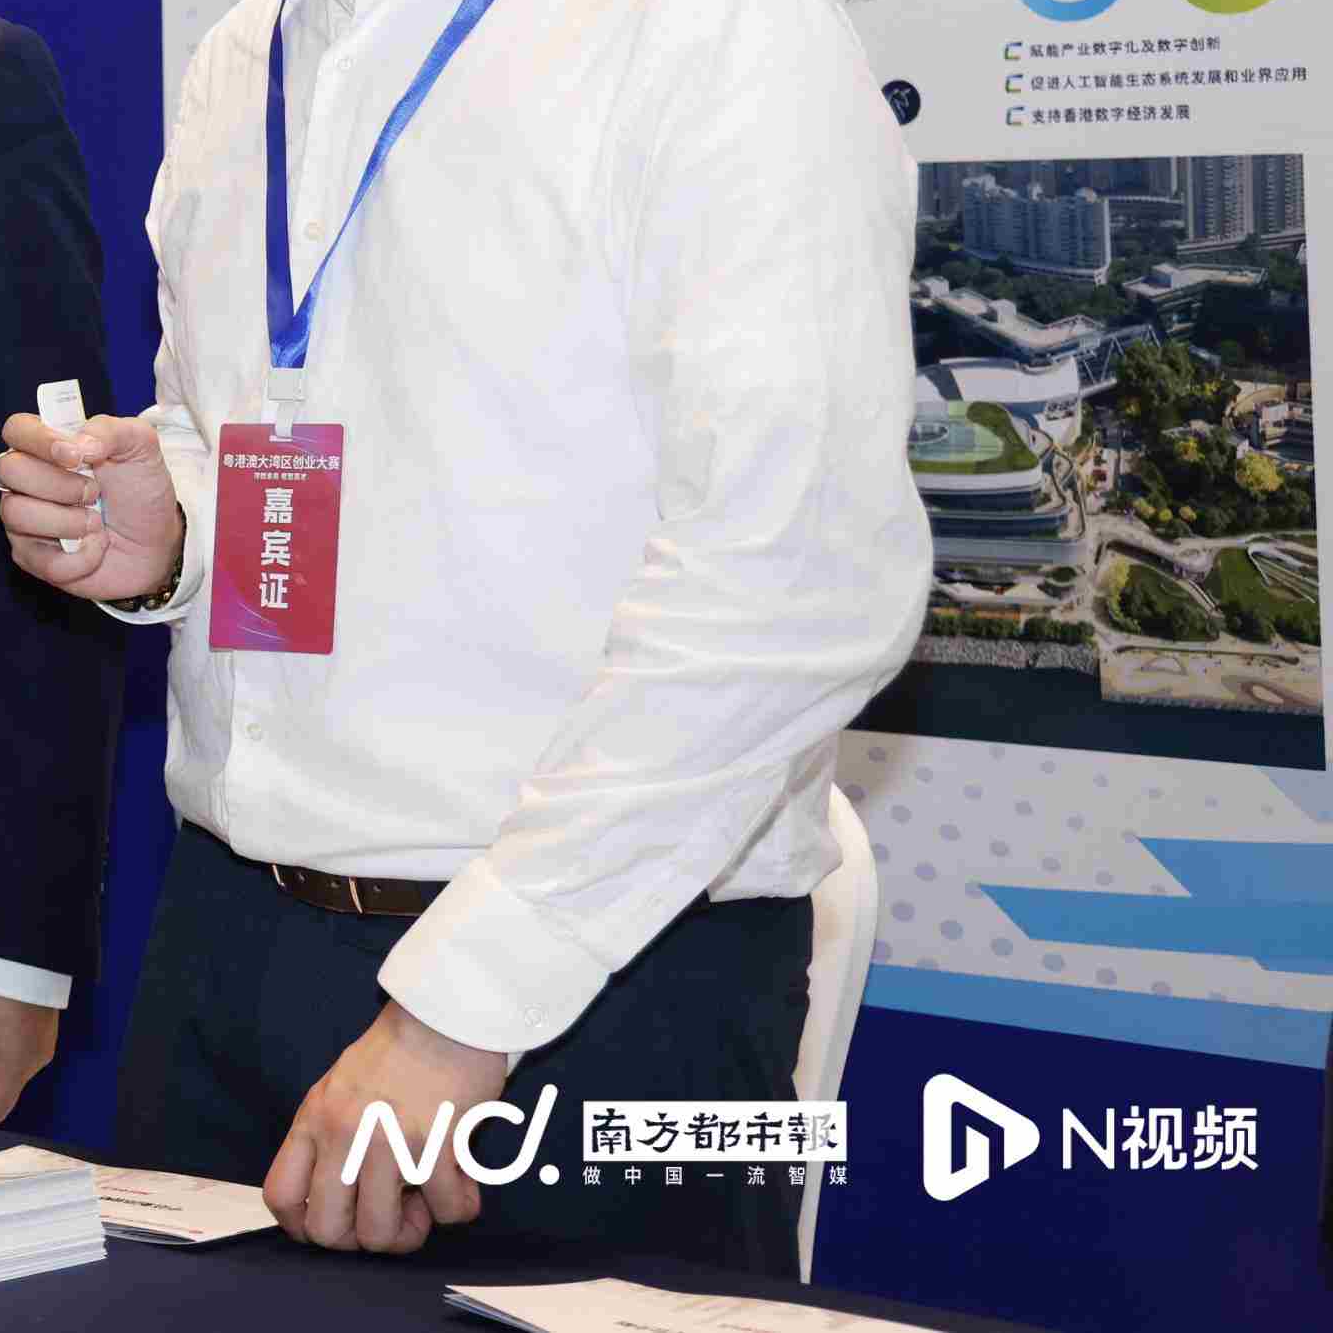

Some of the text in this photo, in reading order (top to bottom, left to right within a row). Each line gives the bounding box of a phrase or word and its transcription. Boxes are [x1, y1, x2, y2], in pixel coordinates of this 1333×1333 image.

[1032, 105, 1190, 125] 支持香港数字经济发展
[259, 487, 294, 609] 嘉宾证
